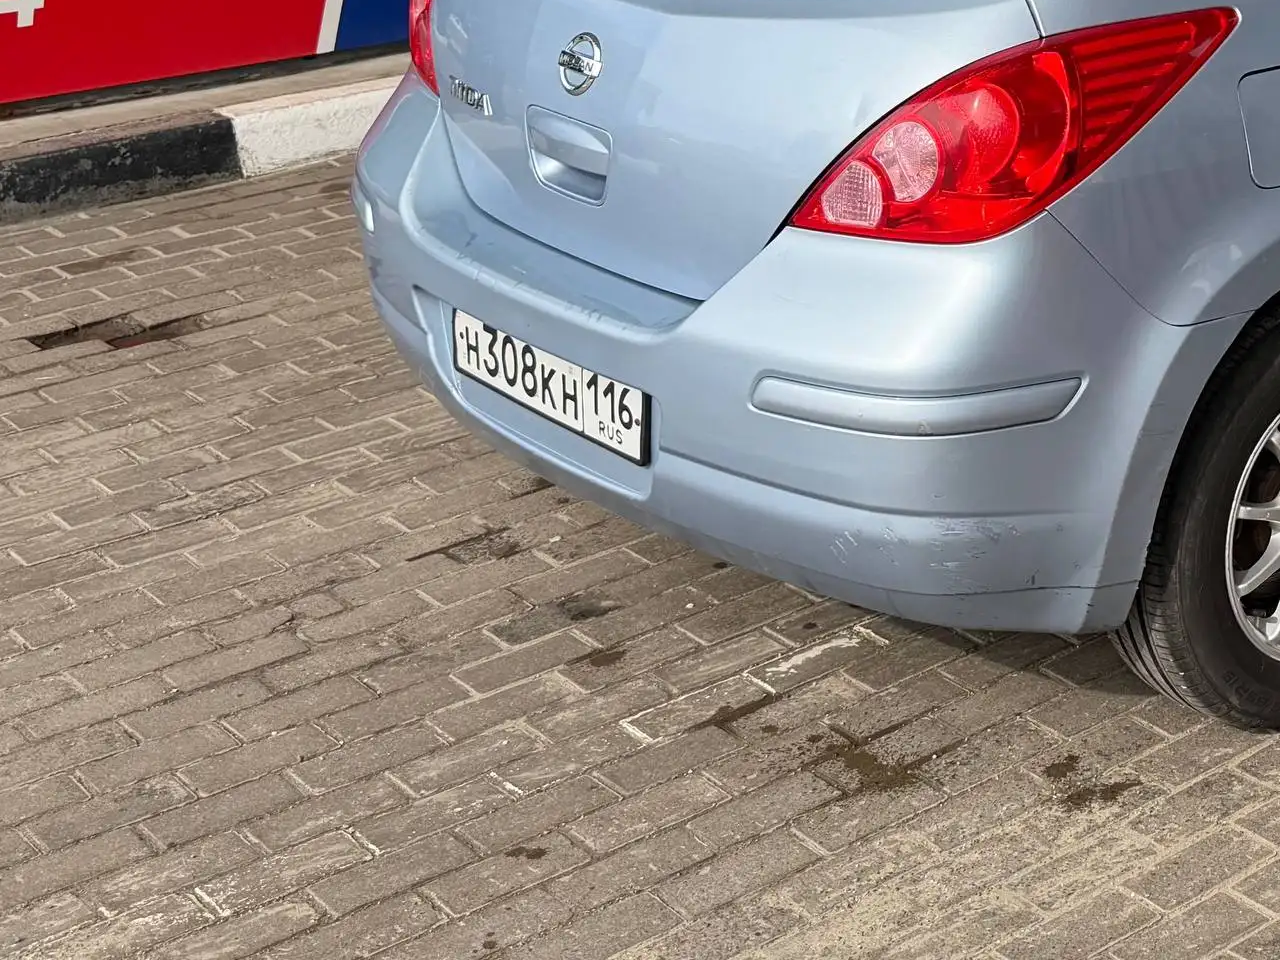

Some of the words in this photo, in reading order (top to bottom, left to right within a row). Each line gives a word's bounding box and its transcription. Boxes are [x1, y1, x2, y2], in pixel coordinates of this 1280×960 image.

[559, 53, 594, 73] NISSAN
[465, 323, 579, 421] Н308КН
[586, 373, 634, 430] 116
[599, 421, 623, 445] RUS
